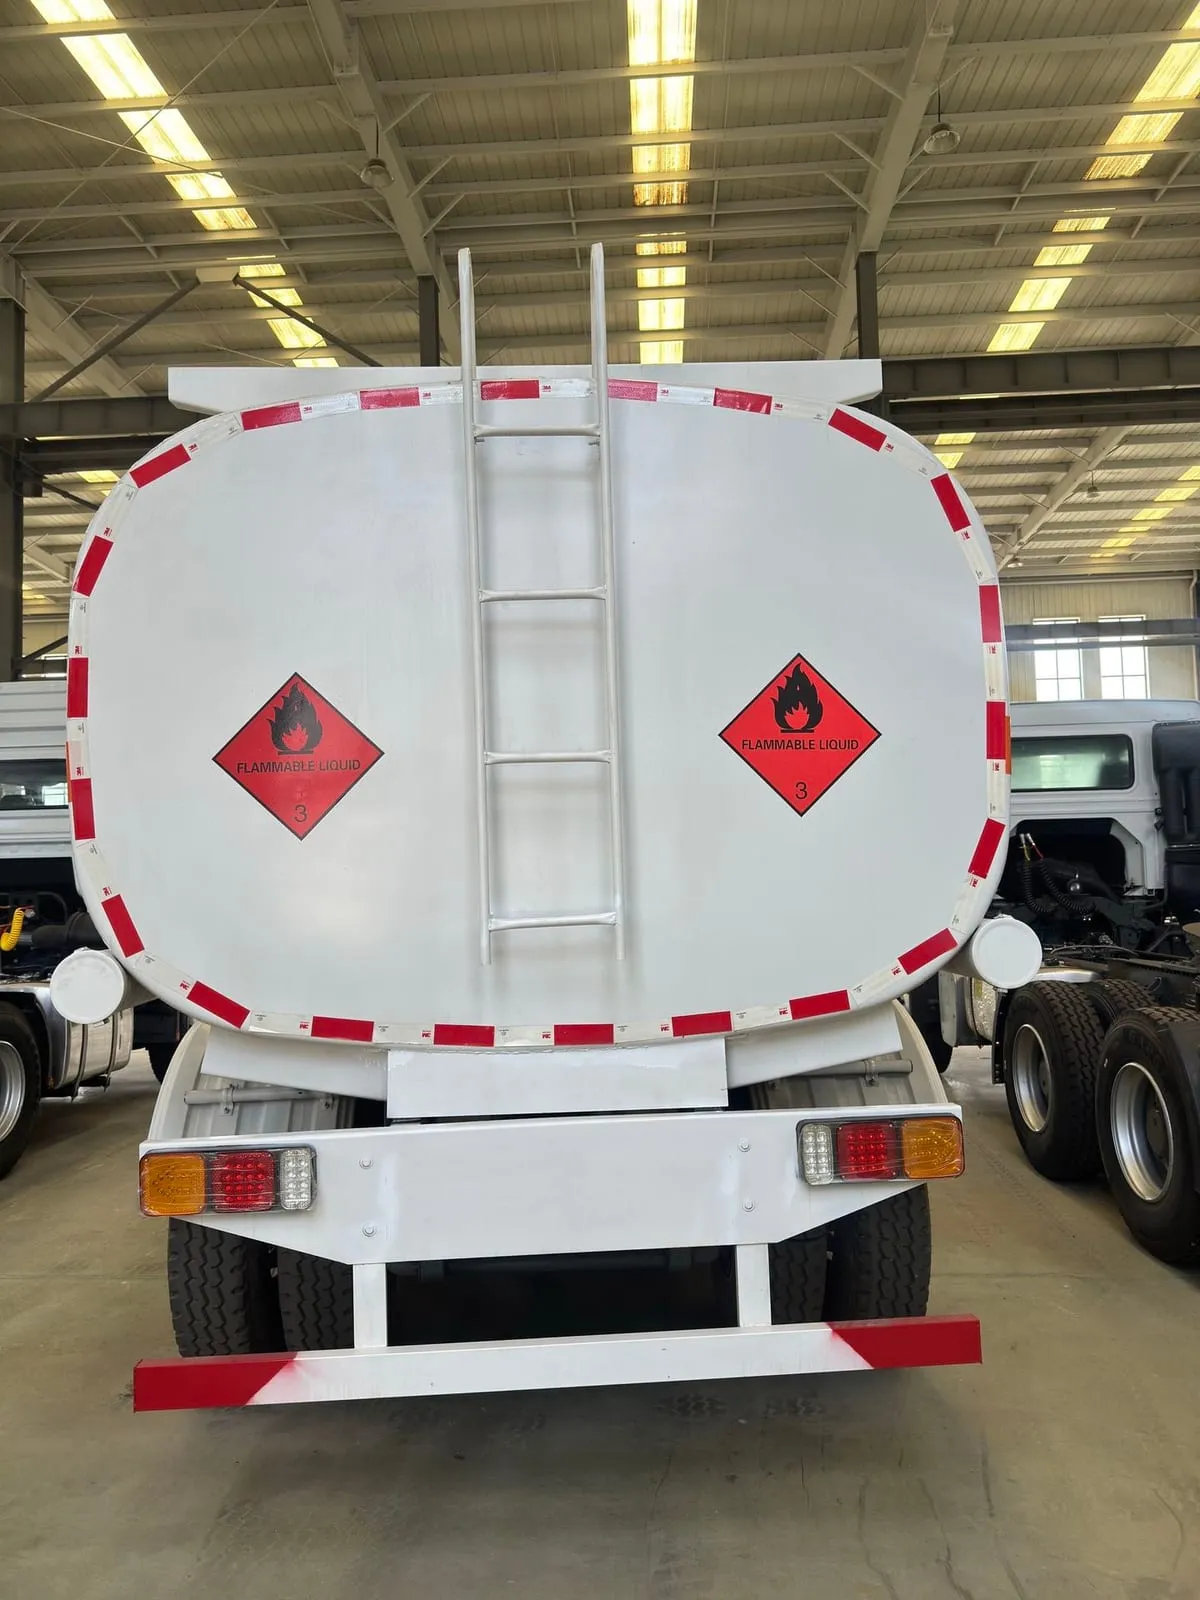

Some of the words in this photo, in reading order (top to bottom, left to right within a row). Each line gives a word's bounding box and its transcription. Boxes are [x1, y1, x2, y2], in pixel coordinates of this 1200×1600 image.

[741, 739, 815, 750] FLAMMABLE
[819, 739, 859, 751] LIQUID
[236, 760, 315, 774] FLAMMABLE
[319, 759, 361, 771] LIQUID
[795, 781, 808, 800] 3
[294, 804, 308, 823] 3
